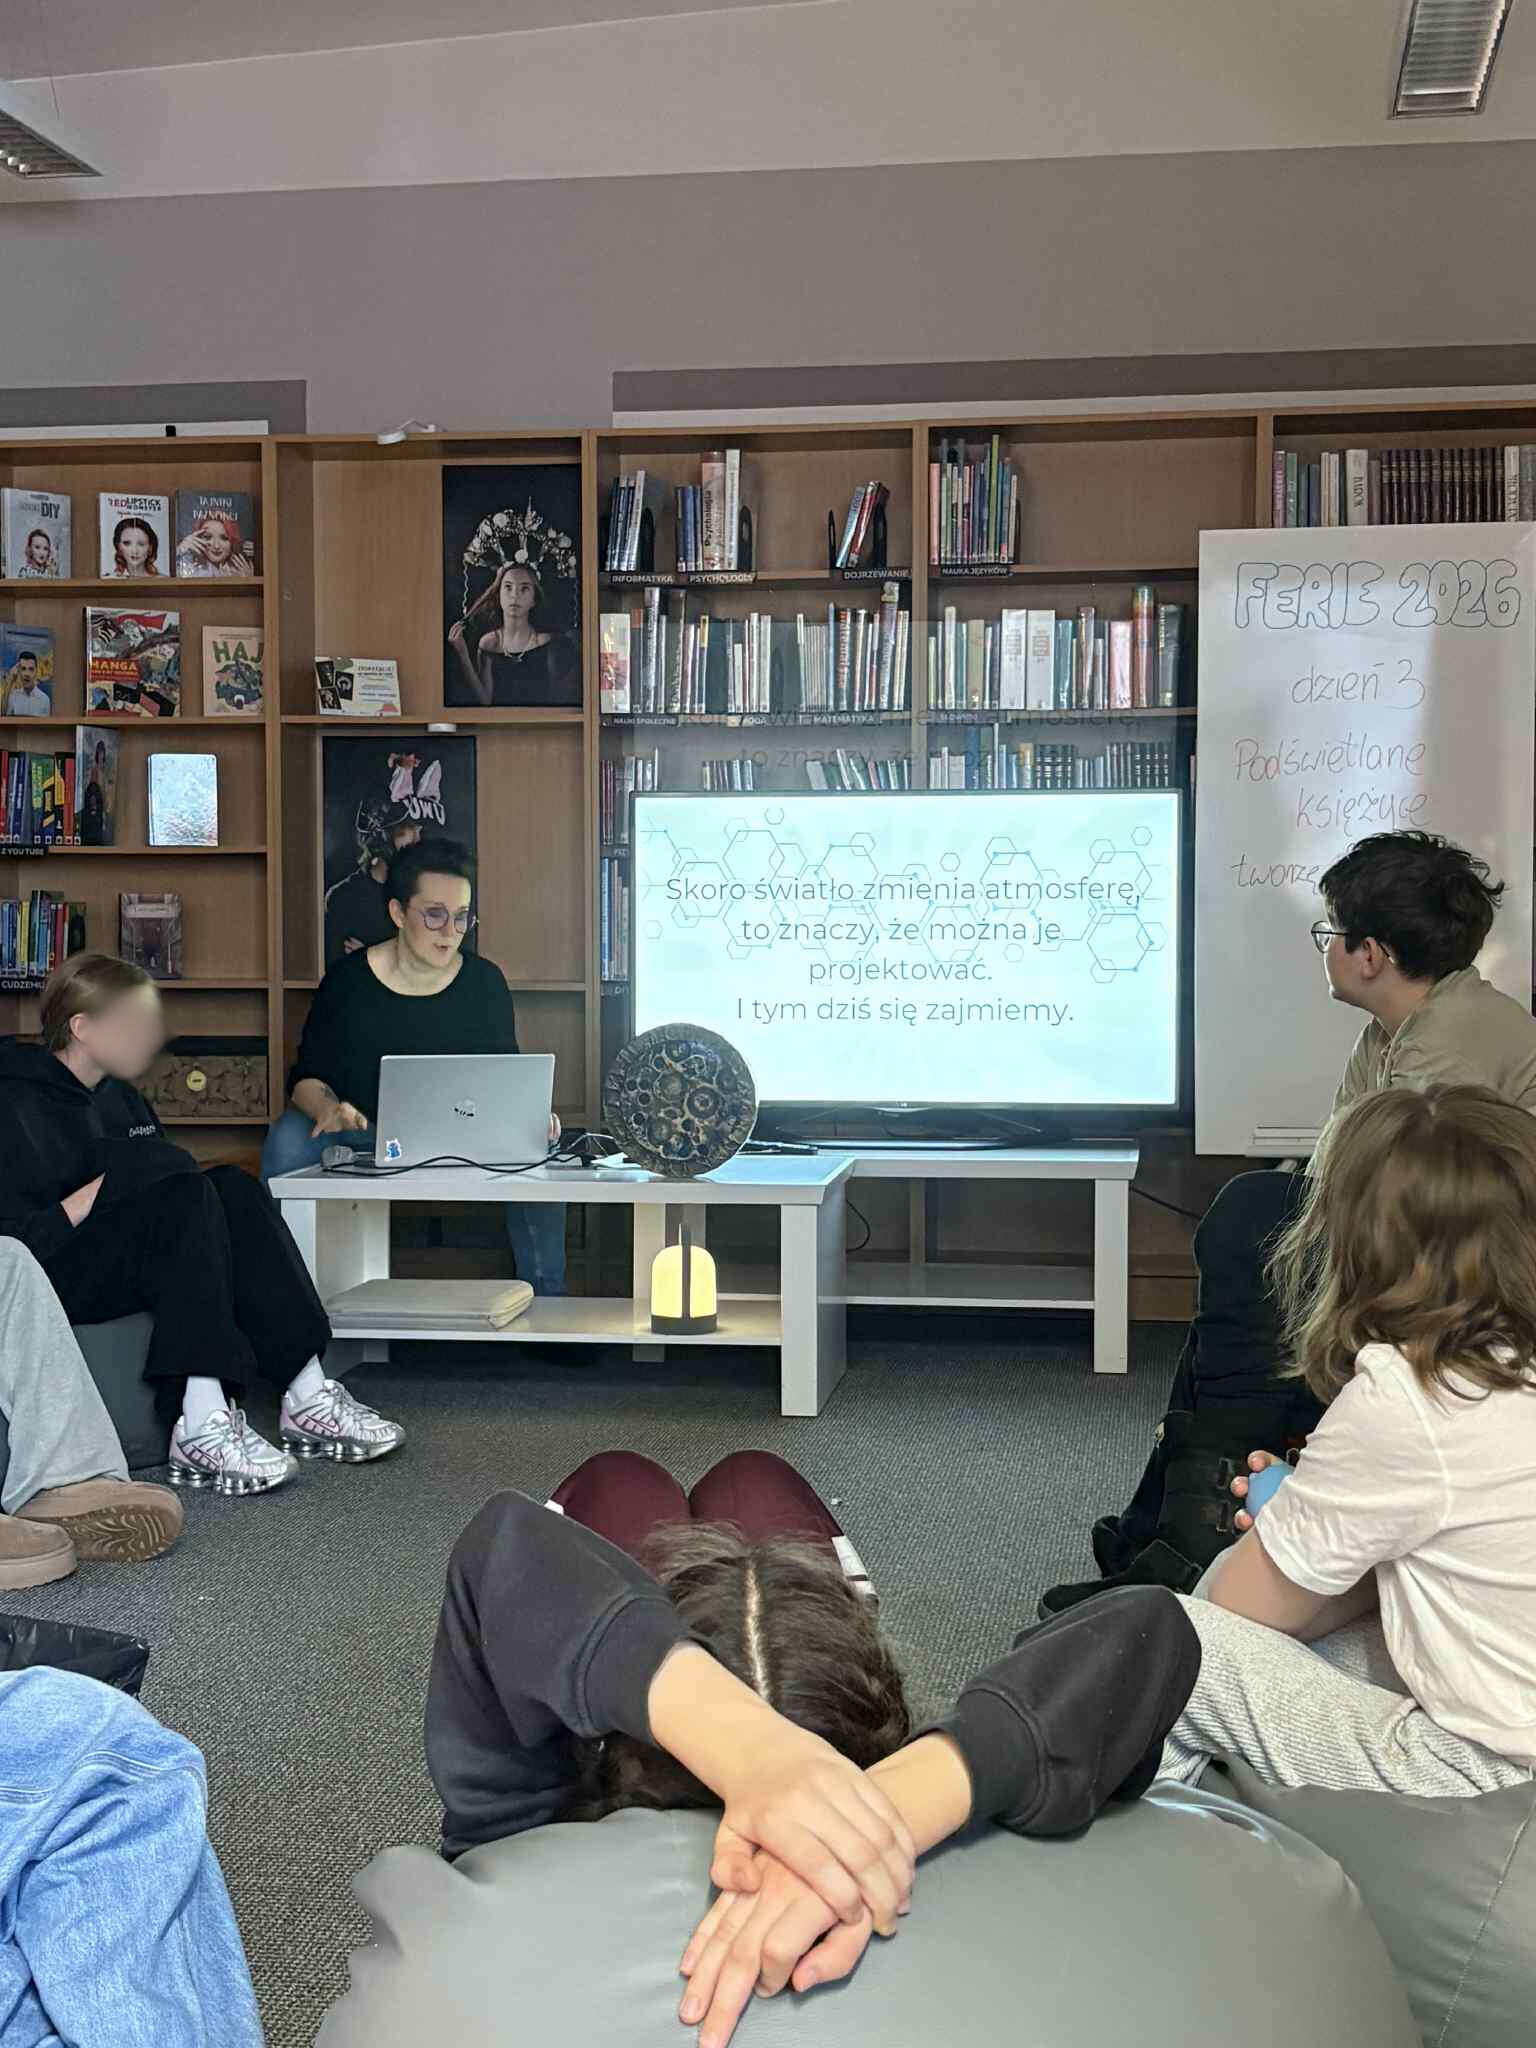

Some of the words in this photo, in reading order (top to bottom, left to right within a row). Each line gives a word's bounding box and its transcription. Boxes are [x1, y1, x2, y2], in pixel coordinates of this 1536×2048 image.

[41, 502, 60, 519] DIY
[612, 574, 674, 583] INFORMATYKA
[1235, 561, 1385, 630] FERIE
[1393, 559, 1521, 629] 2026
[1291, 660, 1385, 705] dzień
[1389, 659, 1425, 710] 3
[1233, 733, 1427, 782] Podświetlane
[1297, 787, 1430, 837] księżyce
[666, 878, 746, 900] Skoro
[754, 877, 854, 900] światło
[863, 877, 976, 900] zmienia
[985, 876, 1141, 909] atmosferę,
[741, 920, 770, 940] to
[779, 922, 880, 945] znaczy,
[888, 917, 920, 940] że
[929, 917, 1027, 940] można
[1033, 917, 1062, 945] je
[809, 957, 993, 985] projektować.
[737, 997, 742, 1019] I
[751, 999, 807, 1025] tym
[817, 996, 872, 1020] dziś
[879, 997, 918, 1026] się
[926, 997, 1074, 1026] zajmiemy.
